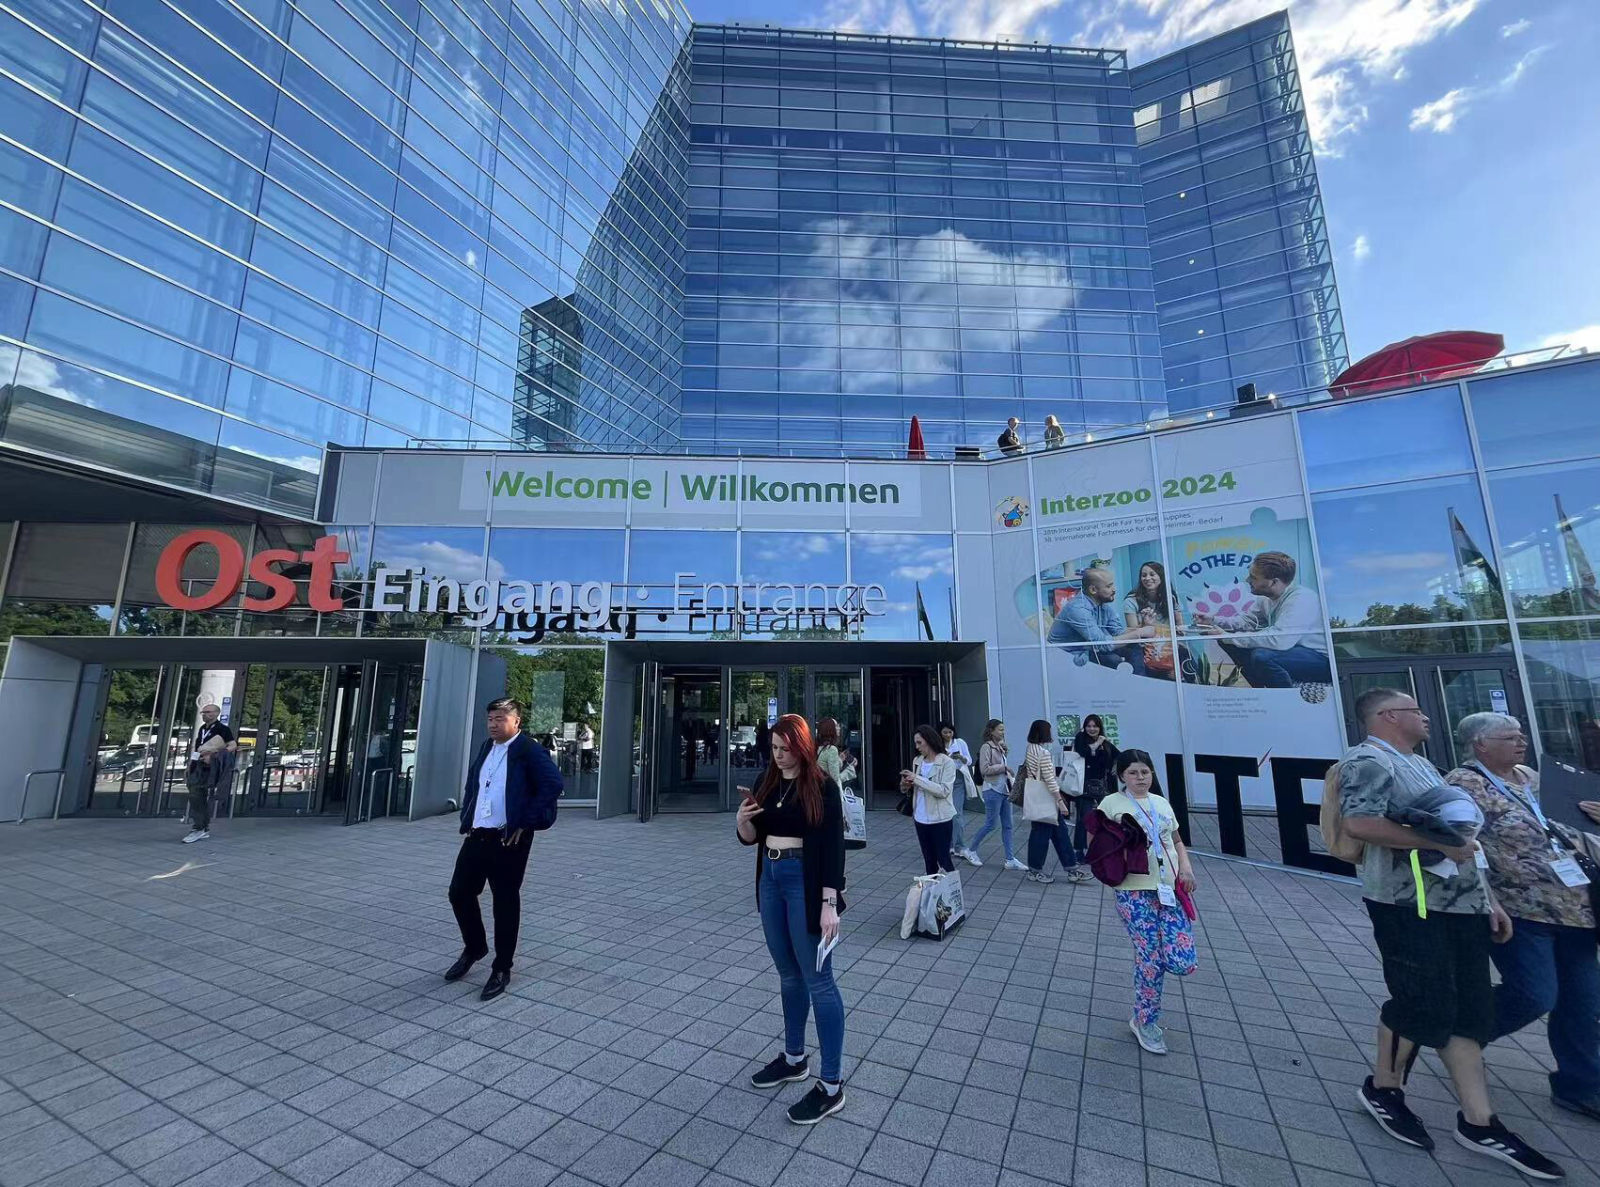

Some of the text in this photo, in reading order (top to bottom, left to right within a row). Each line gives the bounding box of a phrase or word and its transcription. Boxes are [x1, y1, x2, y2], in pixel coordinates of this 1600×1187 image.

[486, 470, 652, 500] Welcome
[680, 474, 900, 504] Willkommen
[1041, 471, 1237, 515] Interzoo 2024
[1058, 522, 1099, 534] International
[1100, 520, 1119, 529] Trade
[1163, 511, 1191, 521] upplies
[1097, 527, 1134, 537] Fachmesse
[155, 529, 349, 612] Ost
[1179, 562, 1203, 579] TO
[1201, 553, 1236, 569] THE
[372, 567, 612, 628] Eingang
[674, 572, 888, 616] Entrance
